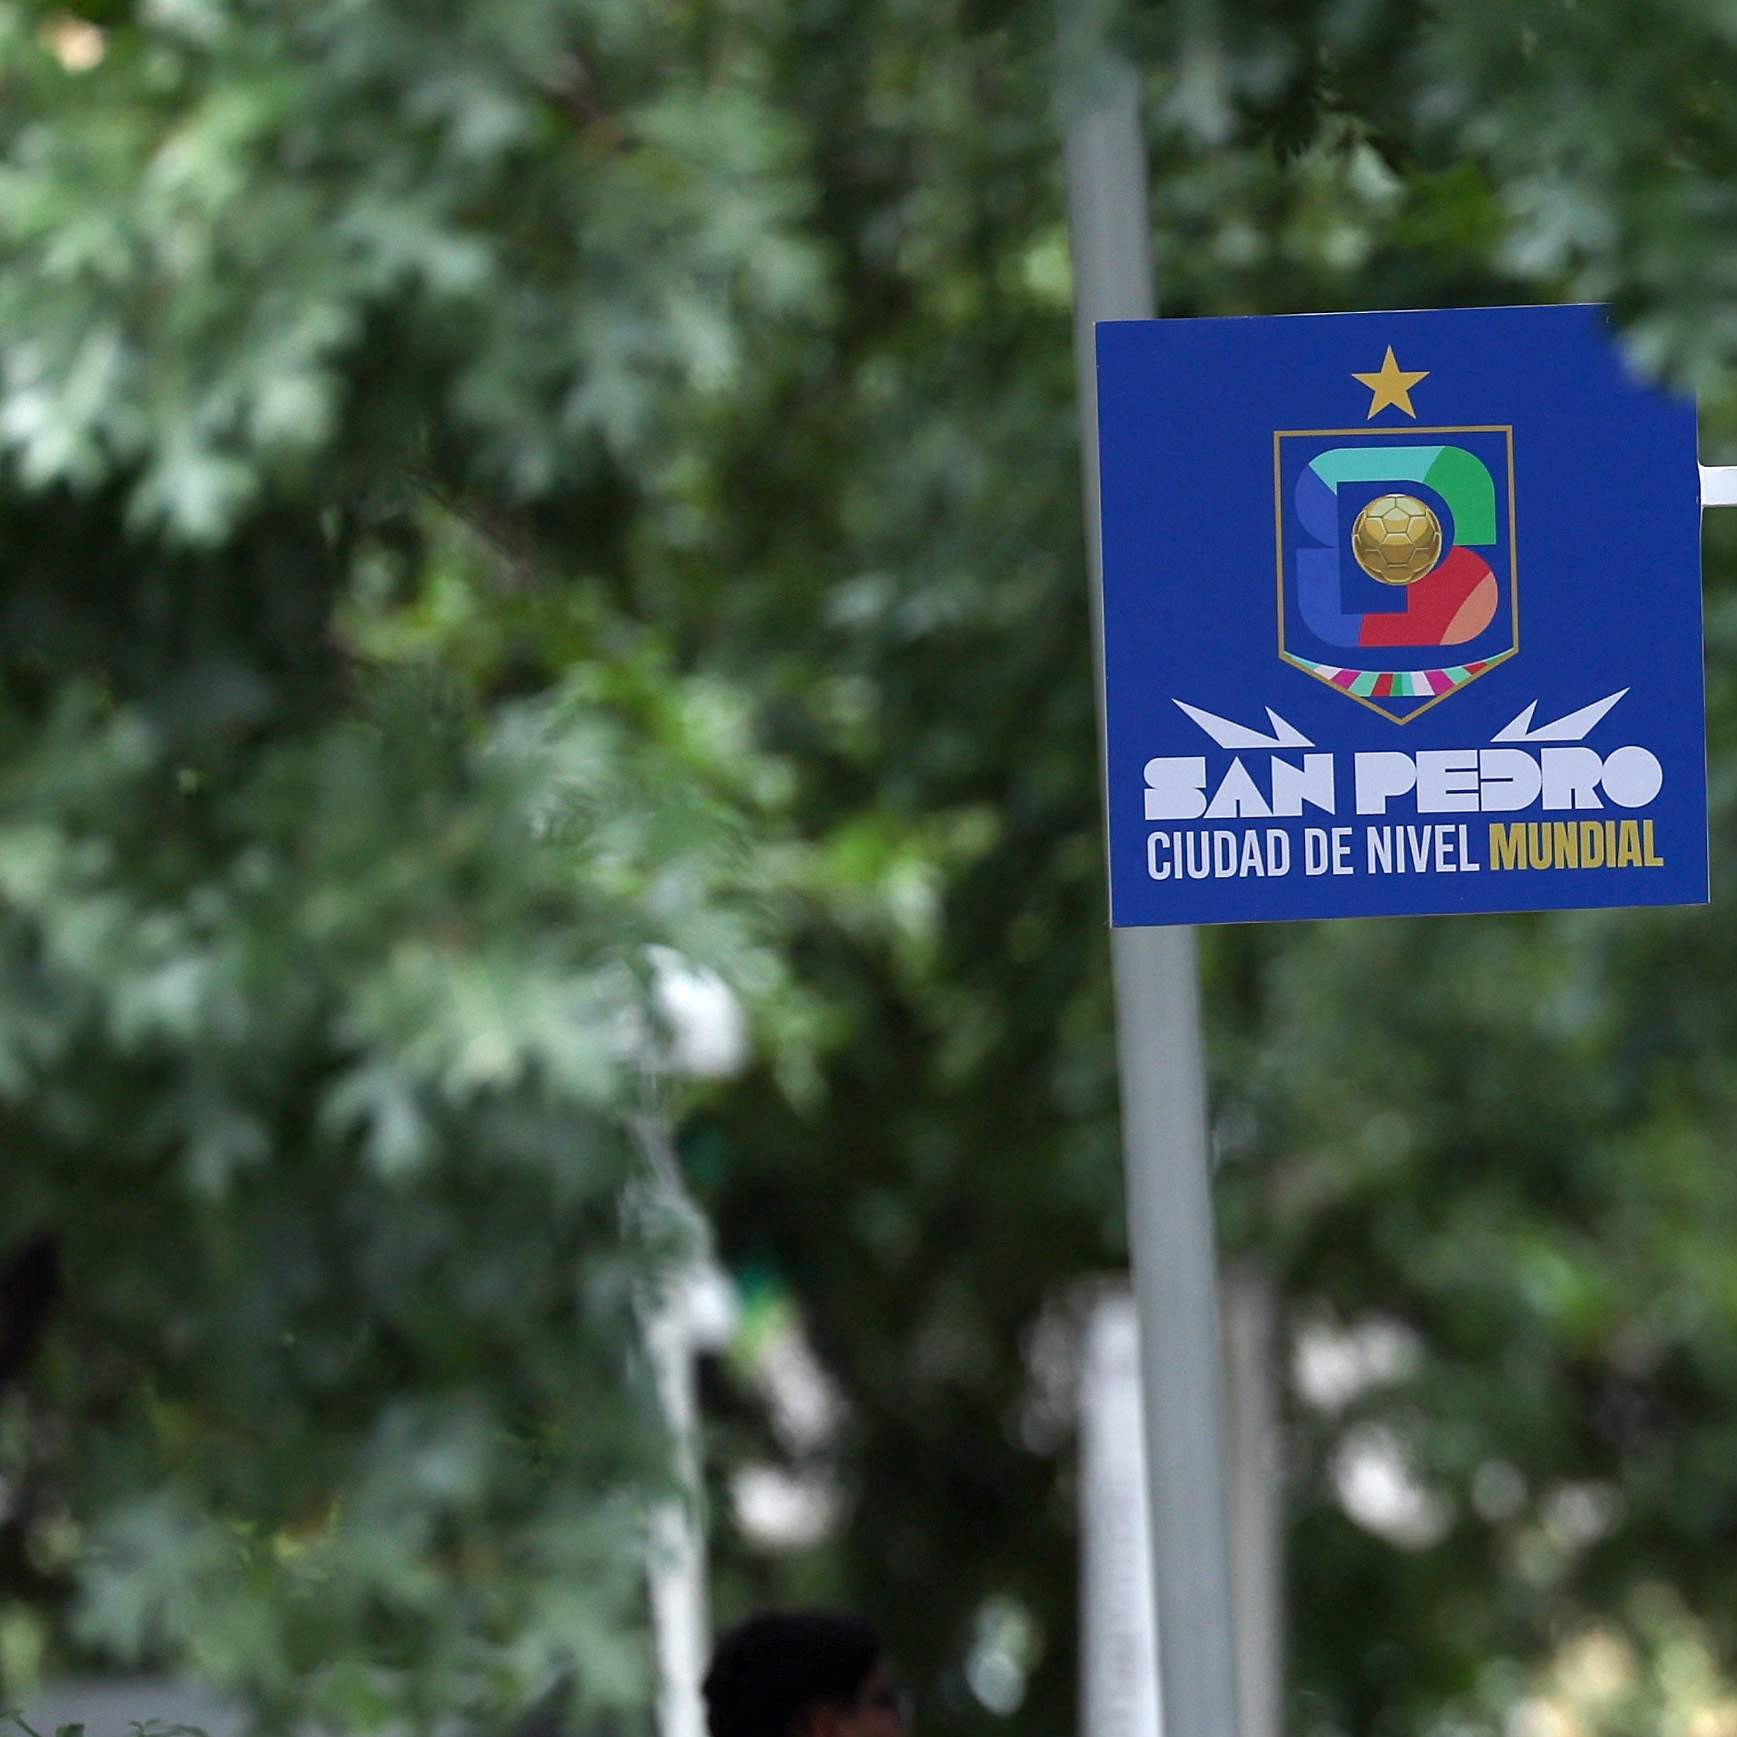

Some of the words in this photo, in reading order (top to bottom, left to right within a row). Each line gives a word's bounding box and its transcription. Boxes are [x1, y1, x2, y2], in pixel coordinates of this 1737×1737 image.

[1143, 753, 1335, 820] SAN
[1354, 745, 1663, 815] PEDRO
[1147, 829, 1290, 880] CIUDAD
[1304, 827, 1354, 876] DE
[1367, 824, 1480, 874] NIVEL
[1489, 820, 1664, 870] MUNDIAL
